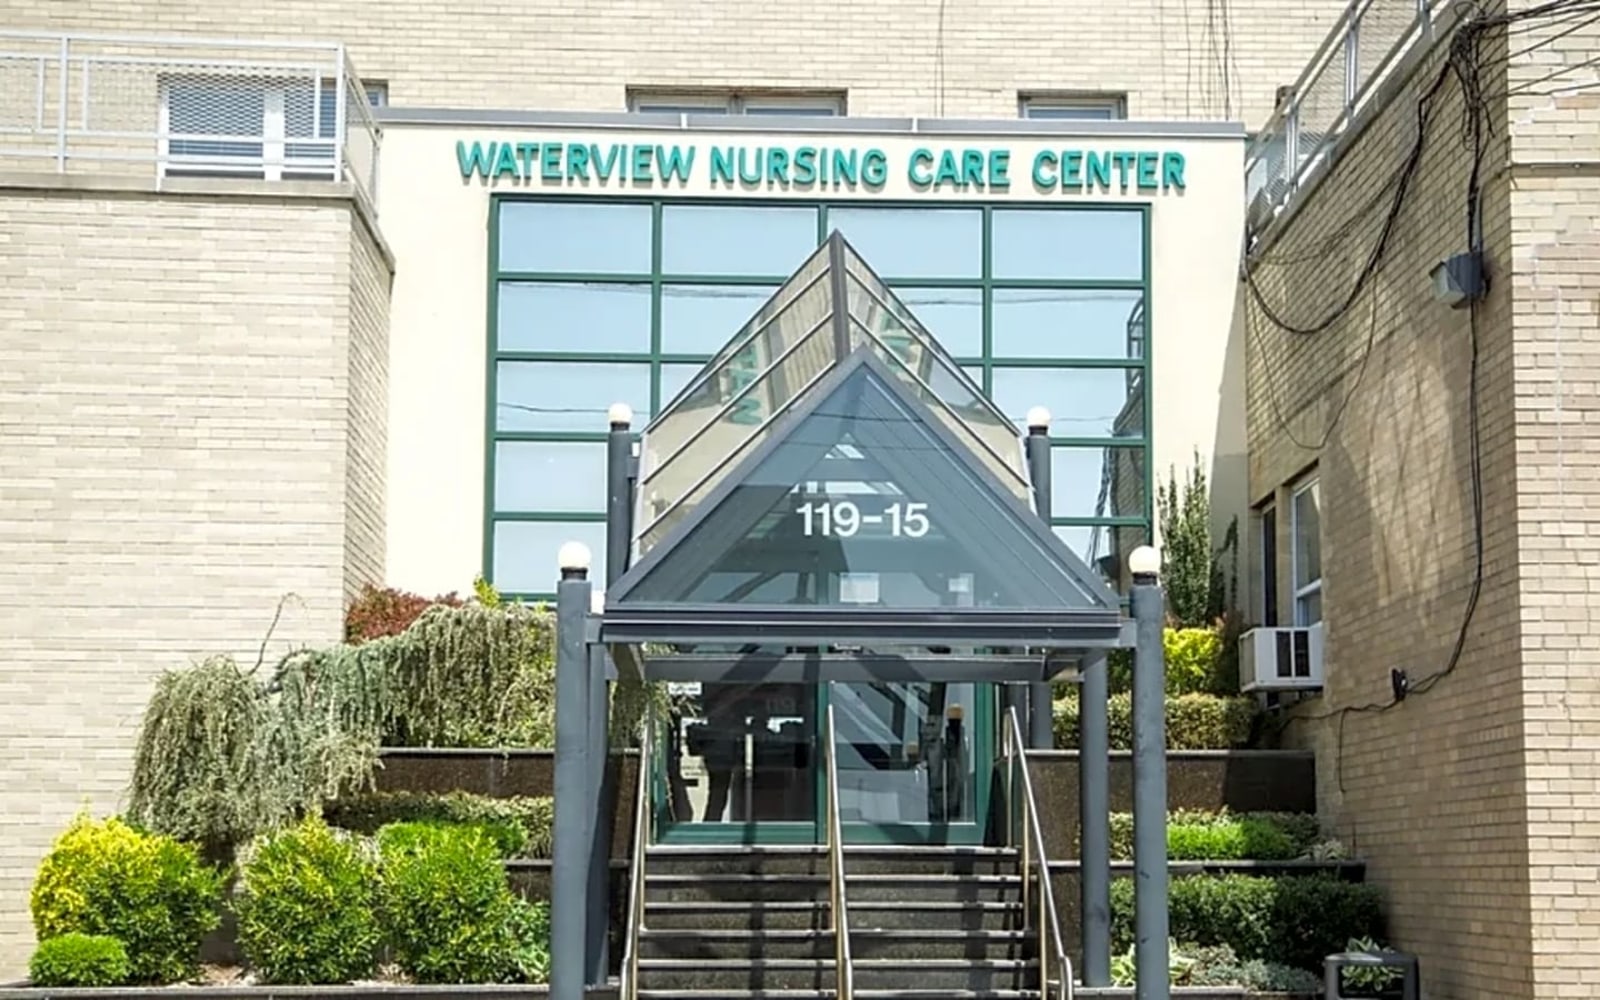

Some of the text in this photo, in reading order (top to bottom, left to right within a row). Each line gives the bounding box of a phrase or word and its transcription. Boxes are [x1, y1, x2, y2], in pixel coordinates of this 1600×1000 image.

[455, 140, 1186, 191] WATERVIEW NURSING CARE CENTER
[796, 501, 930, 537] 119-15
